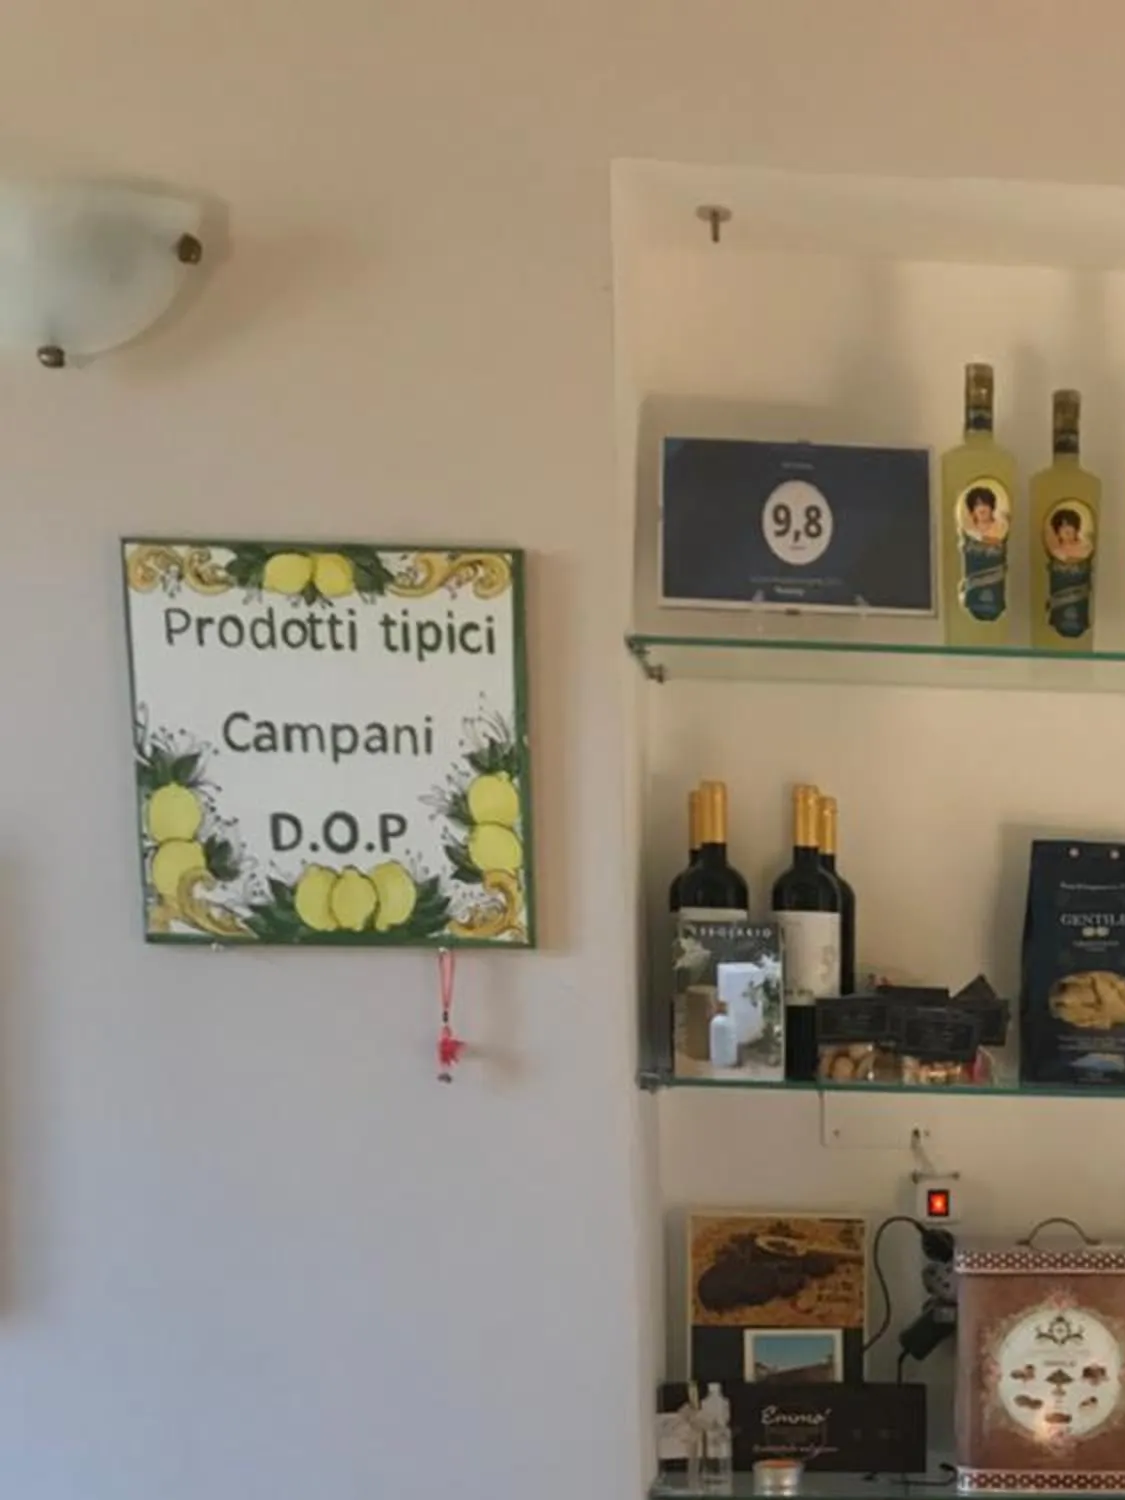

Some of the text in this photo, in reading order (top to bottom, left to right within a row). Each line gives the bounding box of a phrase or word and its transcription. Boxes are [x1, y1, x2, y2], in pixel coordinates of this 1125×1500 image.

[772, 504, 823, 542] 9,8
[164, 607, 497, 662] Prodotti tipici
[222, 711, 434, 763] Campani
[270, 811, 408, 854] D.O.P
